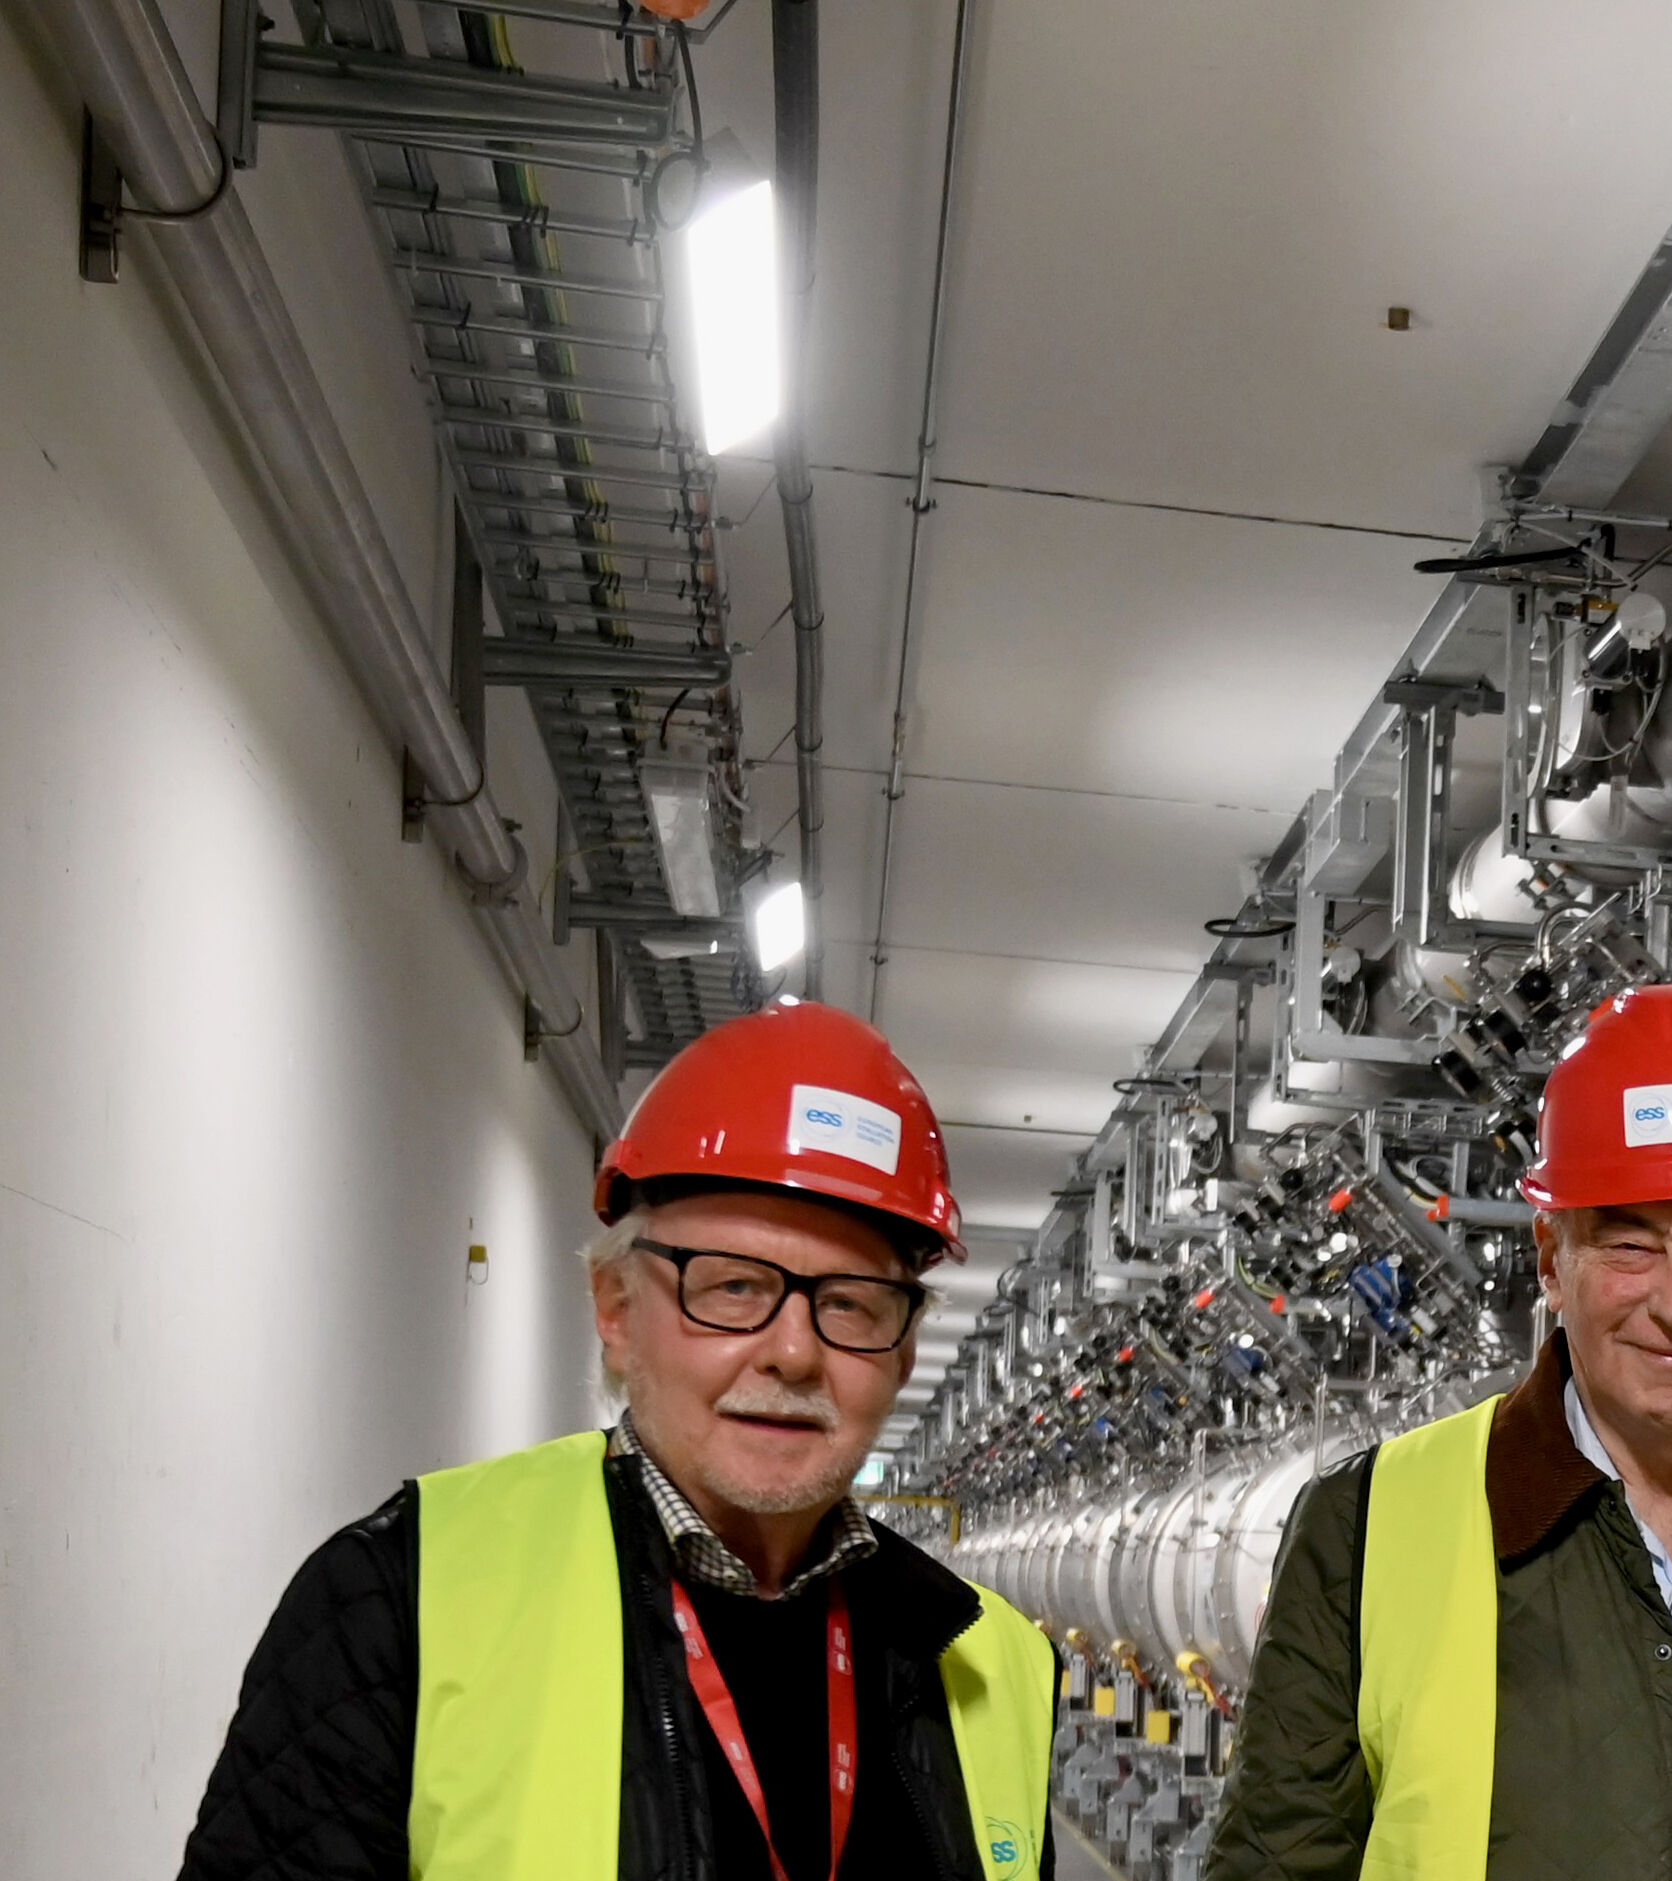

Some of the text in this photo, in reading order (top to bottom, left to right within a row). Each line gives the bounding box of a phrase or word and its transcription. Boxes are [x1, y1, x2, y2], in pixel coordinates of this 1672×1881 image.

[806, 1108, 842, 1127] ess
[1635, 1107, 1665, 1121] ess
[991, 1840, 1017, 1864] ss
